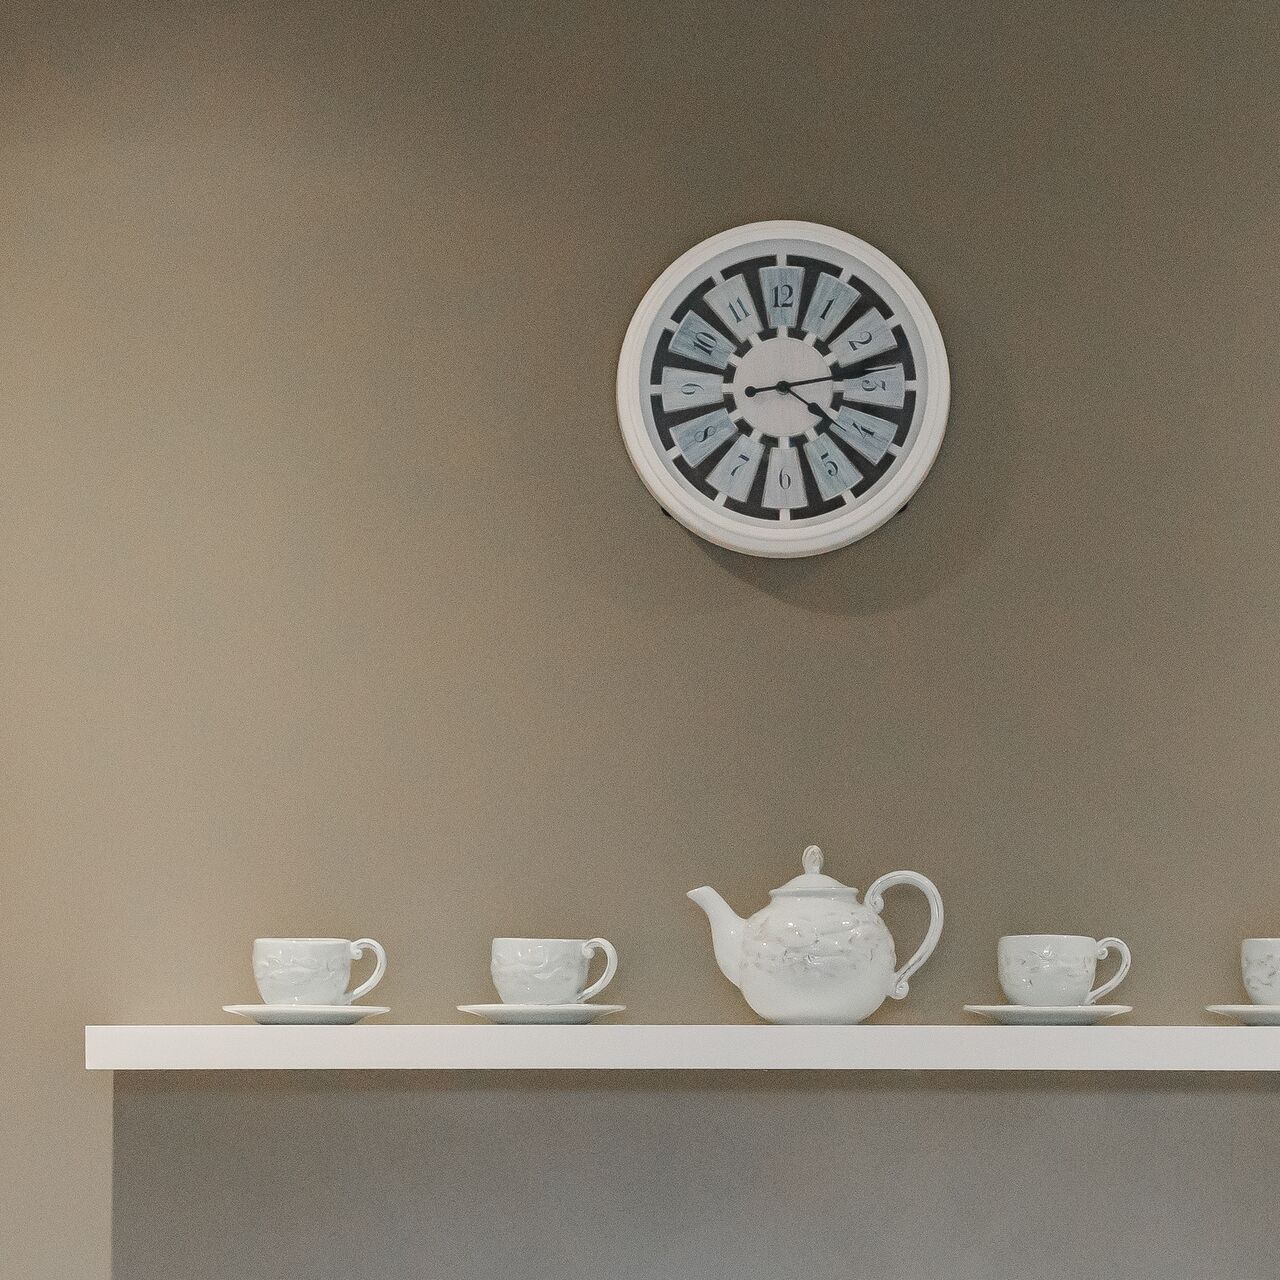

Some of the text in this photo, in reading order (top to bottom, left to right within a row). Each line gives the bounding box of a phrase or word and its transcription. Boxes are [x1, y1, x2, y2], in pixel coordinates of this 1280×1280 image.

[772, 284, 794, 308] 12
[727, 296, 752, 323] 11
[820, 298, 836, 320] 1
[693, 331, 719, 356] 10
[848, 330, 873, 351] 2
[681, 383, 705, 396] 9
[861, 379, 886, 392] 3
[695, 425, 717, 443] 8
[850, 421, 875, 438] 4
[730, 453, 751, 477] 7
[820, 452, 839, 477] 5
[778, 467, 792, 490] 6
